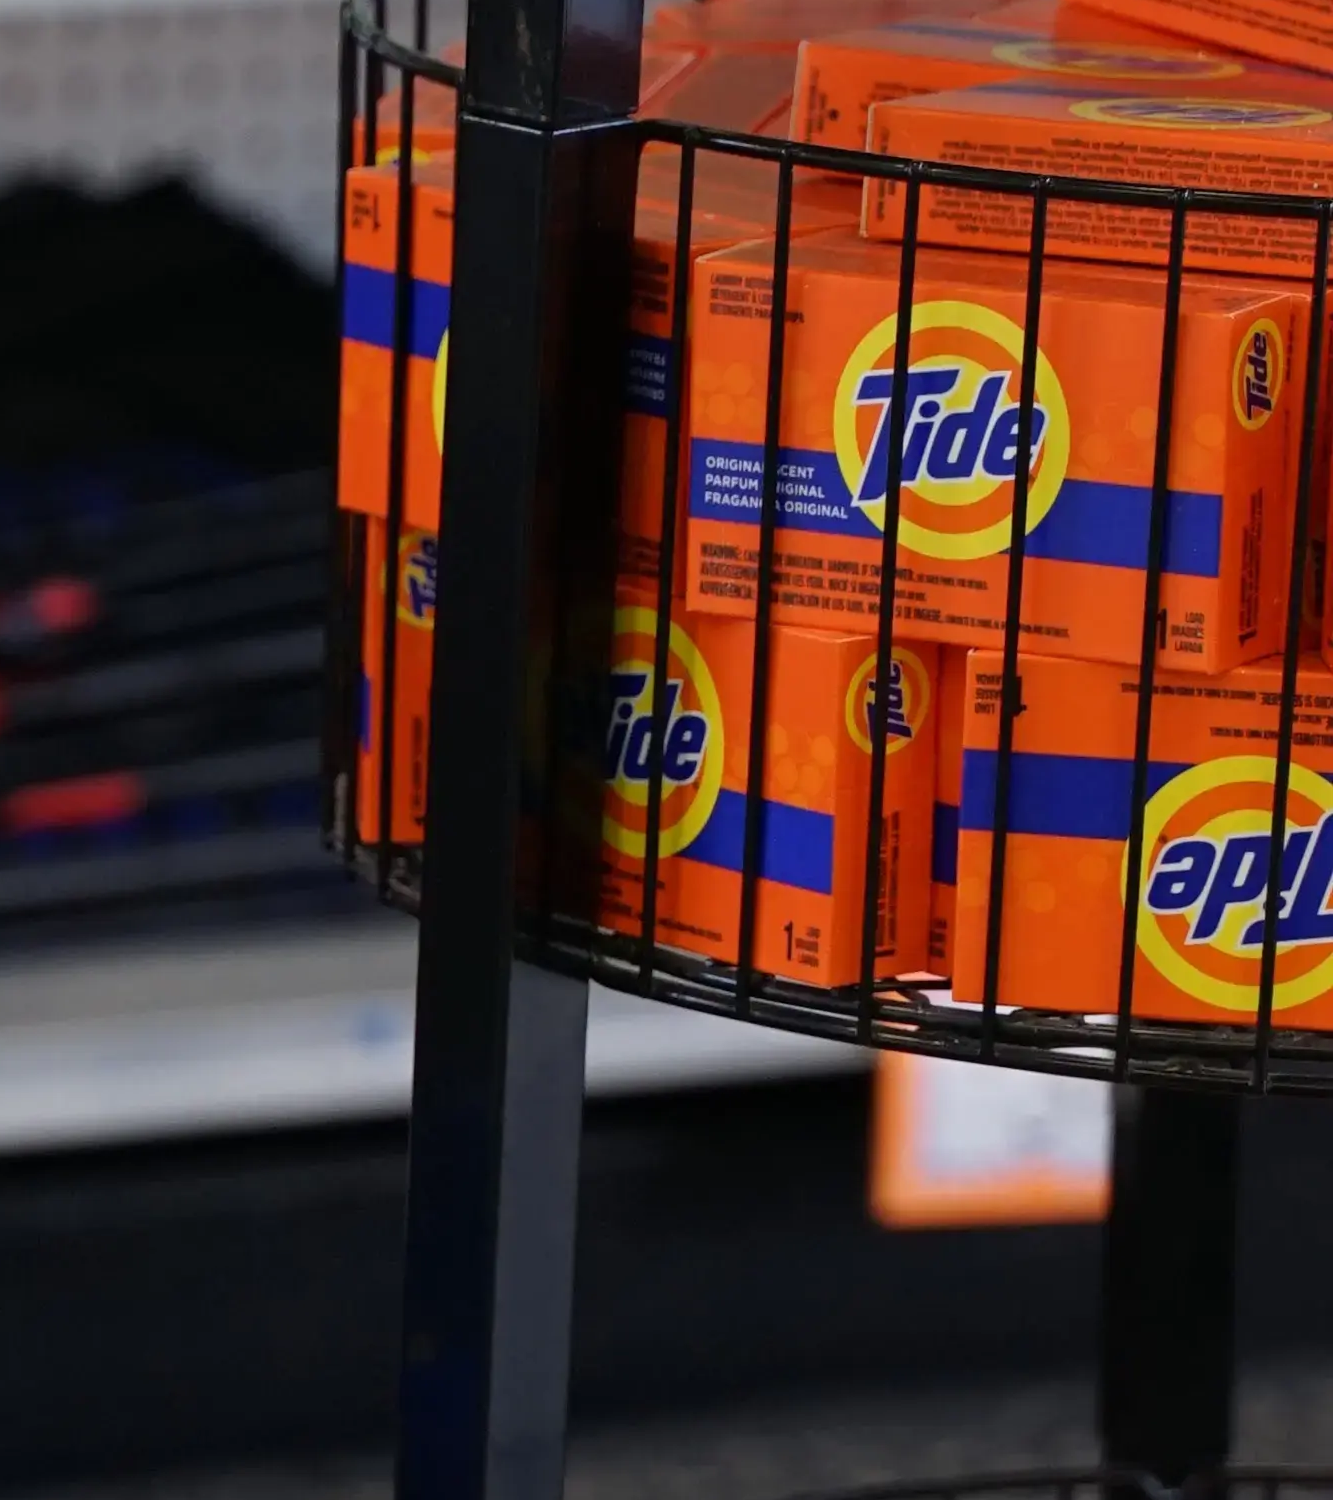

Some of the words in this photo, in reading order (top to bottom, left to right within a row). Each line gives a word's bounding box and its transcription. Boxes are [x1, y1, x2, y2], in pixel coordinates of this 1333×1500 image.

[1245, 331, 1272, 421] Tide
[851, 364, 1049, 508] Tide
[705, 473, 759, 491] PARFUM
[776, 463, 815, 480] CENT
[784, 500, 849, 520] ORIGINAL
[1146, 810, 1333, 950] Tide
